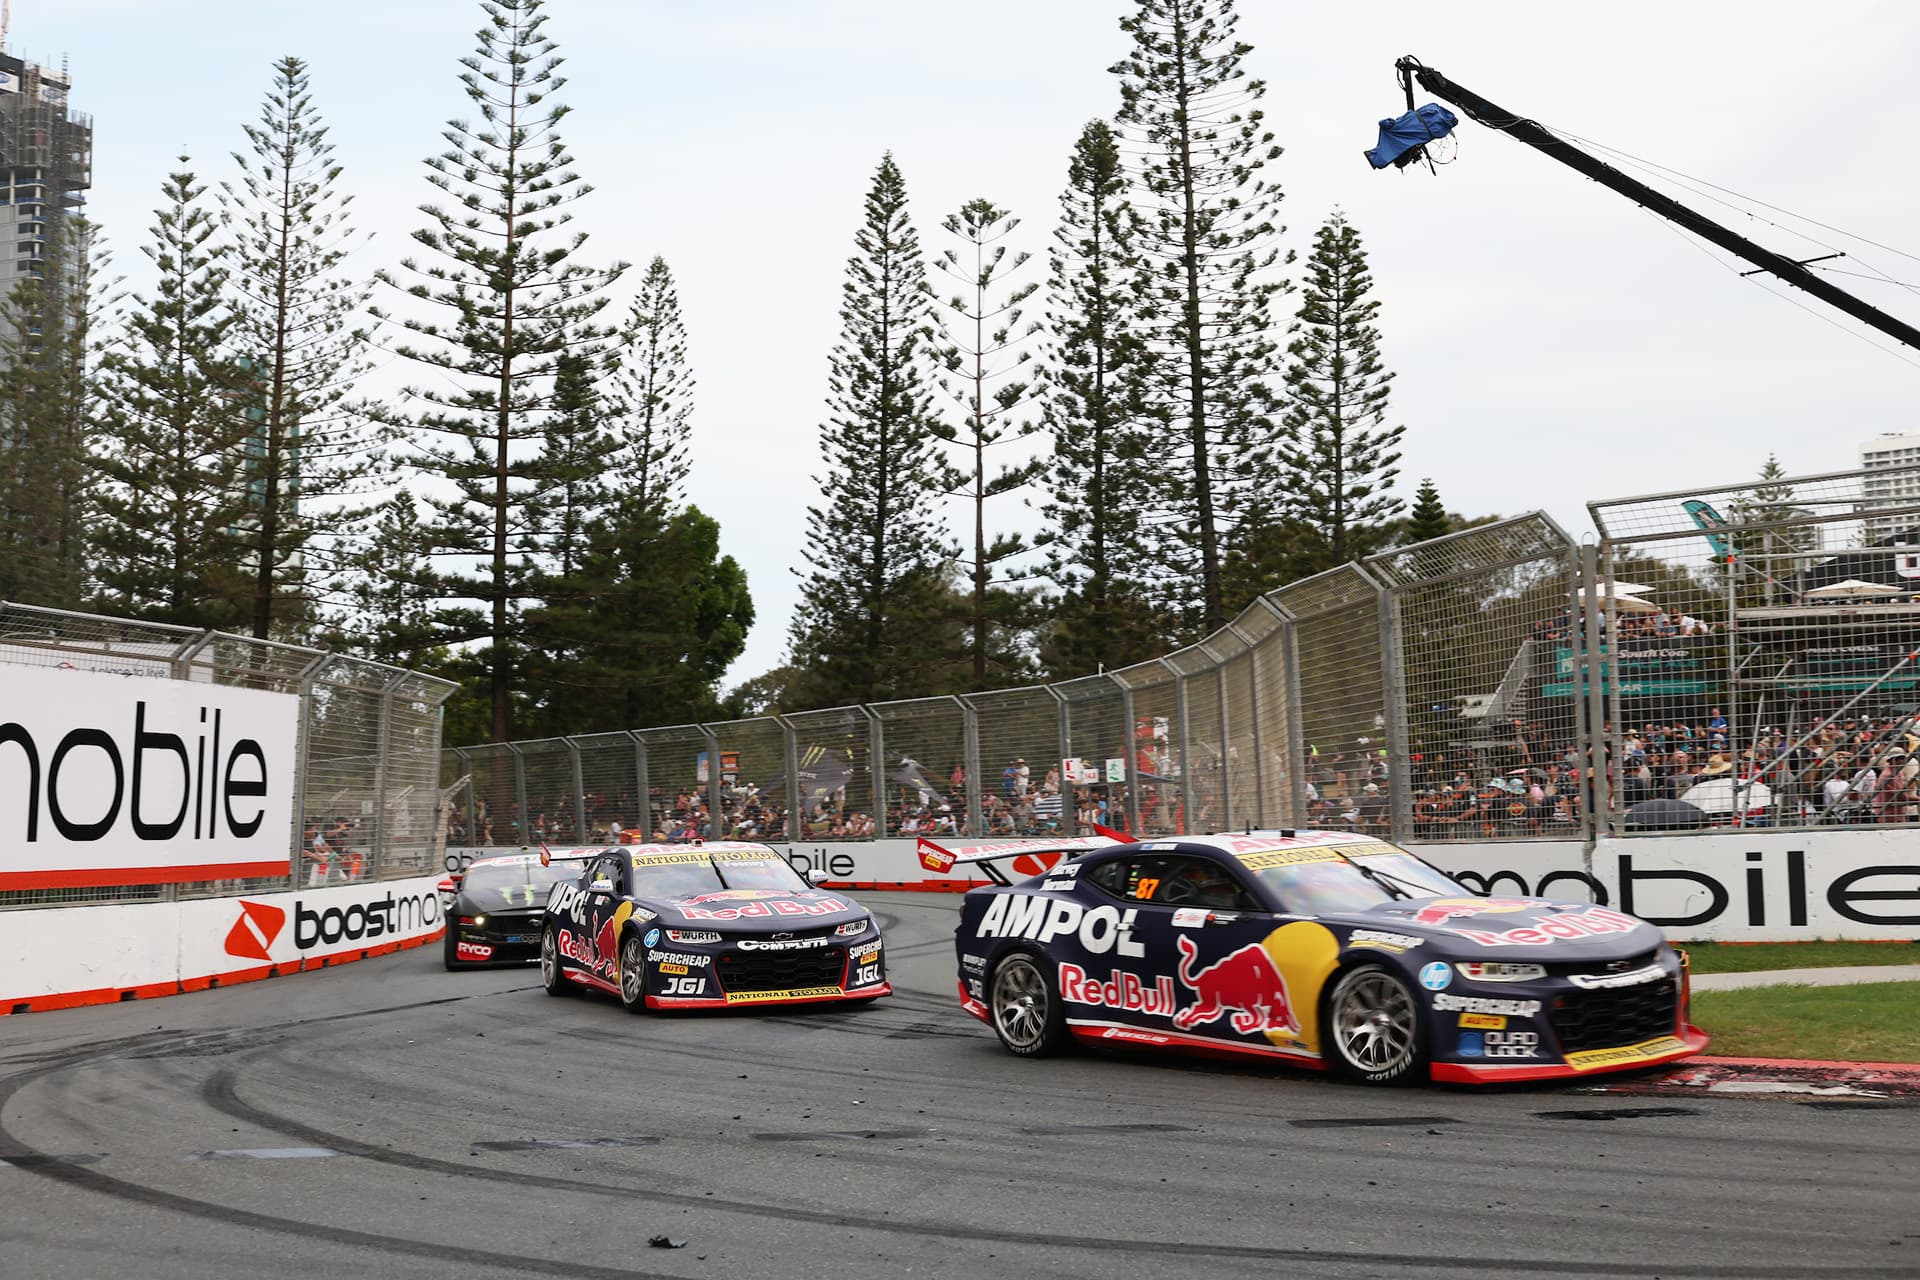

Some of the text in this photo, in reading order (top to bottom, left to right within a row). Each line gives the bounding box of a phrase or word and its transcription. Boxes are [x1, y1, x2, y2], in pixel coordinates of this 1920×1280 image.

[635, 853, 709, 867] NATIONAL
[712, 851, 780, 862] STORAGE
[789, 848, 855, 877] bile
[927, 856, 940, 868] AUTO
[1135, 878, 1160, 899] 87
[677, 901, 772, 920] Red
[769, 898, 848, 917] Bull
[976, 893, 1145, 958] AMPOL
[1440, 912, 1593, 947] Red
[458, 942, 492, 956] RYCO
[647, 949, 711, 968] SUPERCHEAP
[662, 964, 686, 973] AUTO
[661, 977, 706, 995] JGI
[730, 987, 841, 1001] NATIONAL STORAGE
[1058, 961, 1176, 1017] Red Bull
[1485, 1032, 1539, 1045] QUAD
[1485, 1045, 1540, 1058] LOCK
